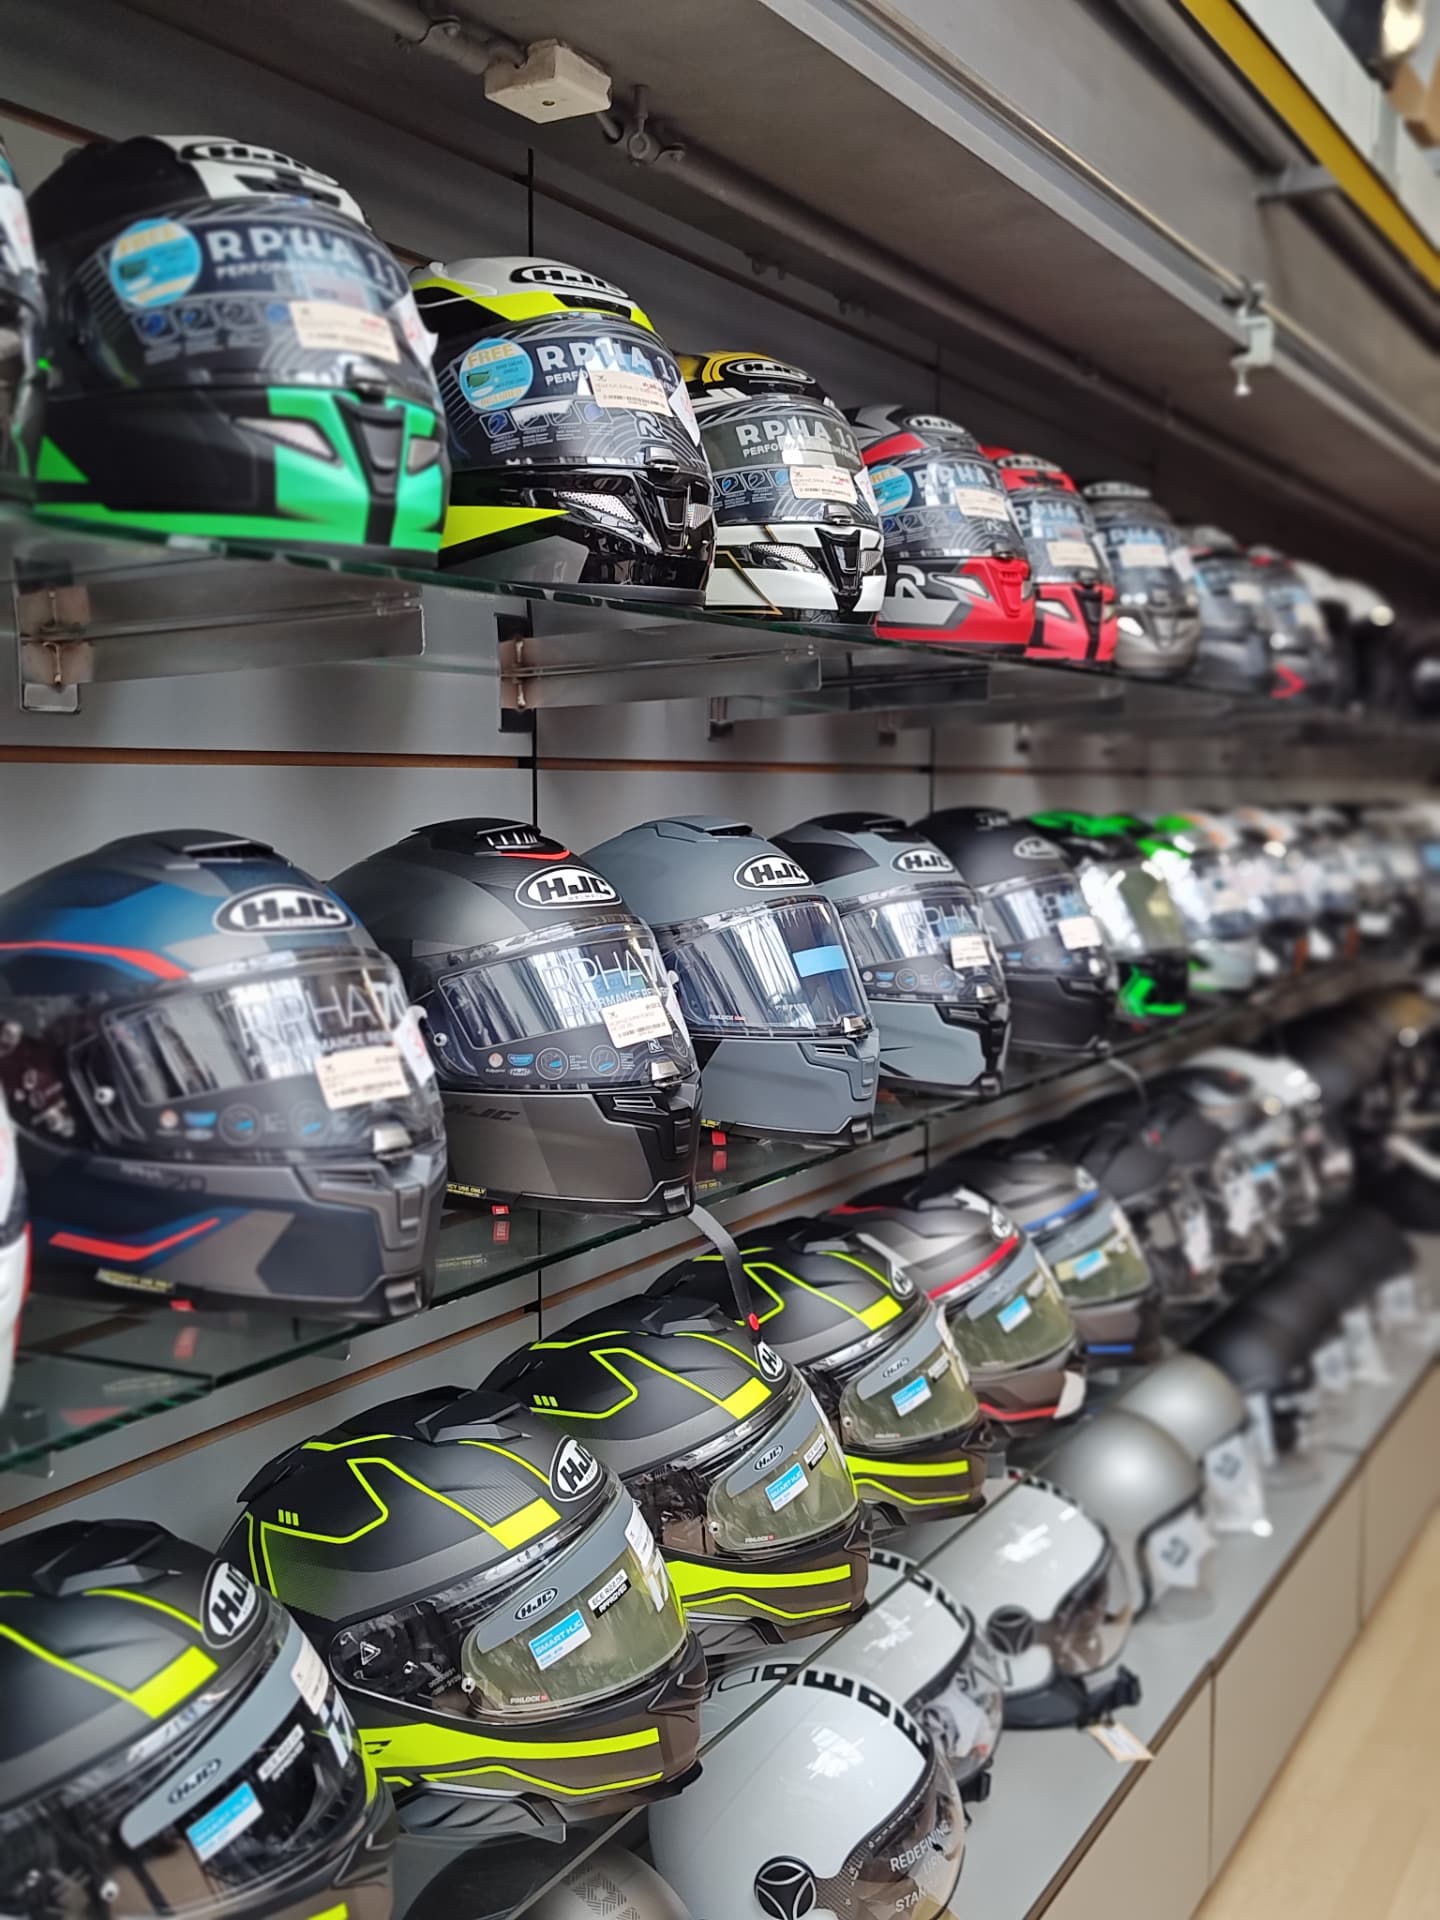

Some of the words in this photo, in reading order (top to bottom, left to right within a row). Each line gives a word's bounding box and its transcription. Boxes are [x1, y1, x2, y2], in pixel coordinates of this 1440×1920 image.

[205, 226, 361, 268] RPHA
[467, 342, 513, 369] FREE
[735, 417, 831, 447] RPHA
[535, 875, 612, 902] HJC
[241, 897, 341, 927] HJC
[759, 1446, 781, 1469] HJC
[520, 1590, 553, 1618] HJC
[536, 1629, 567, 1655] SMART
[890, 1819, 952, 1873] REDEFINING
